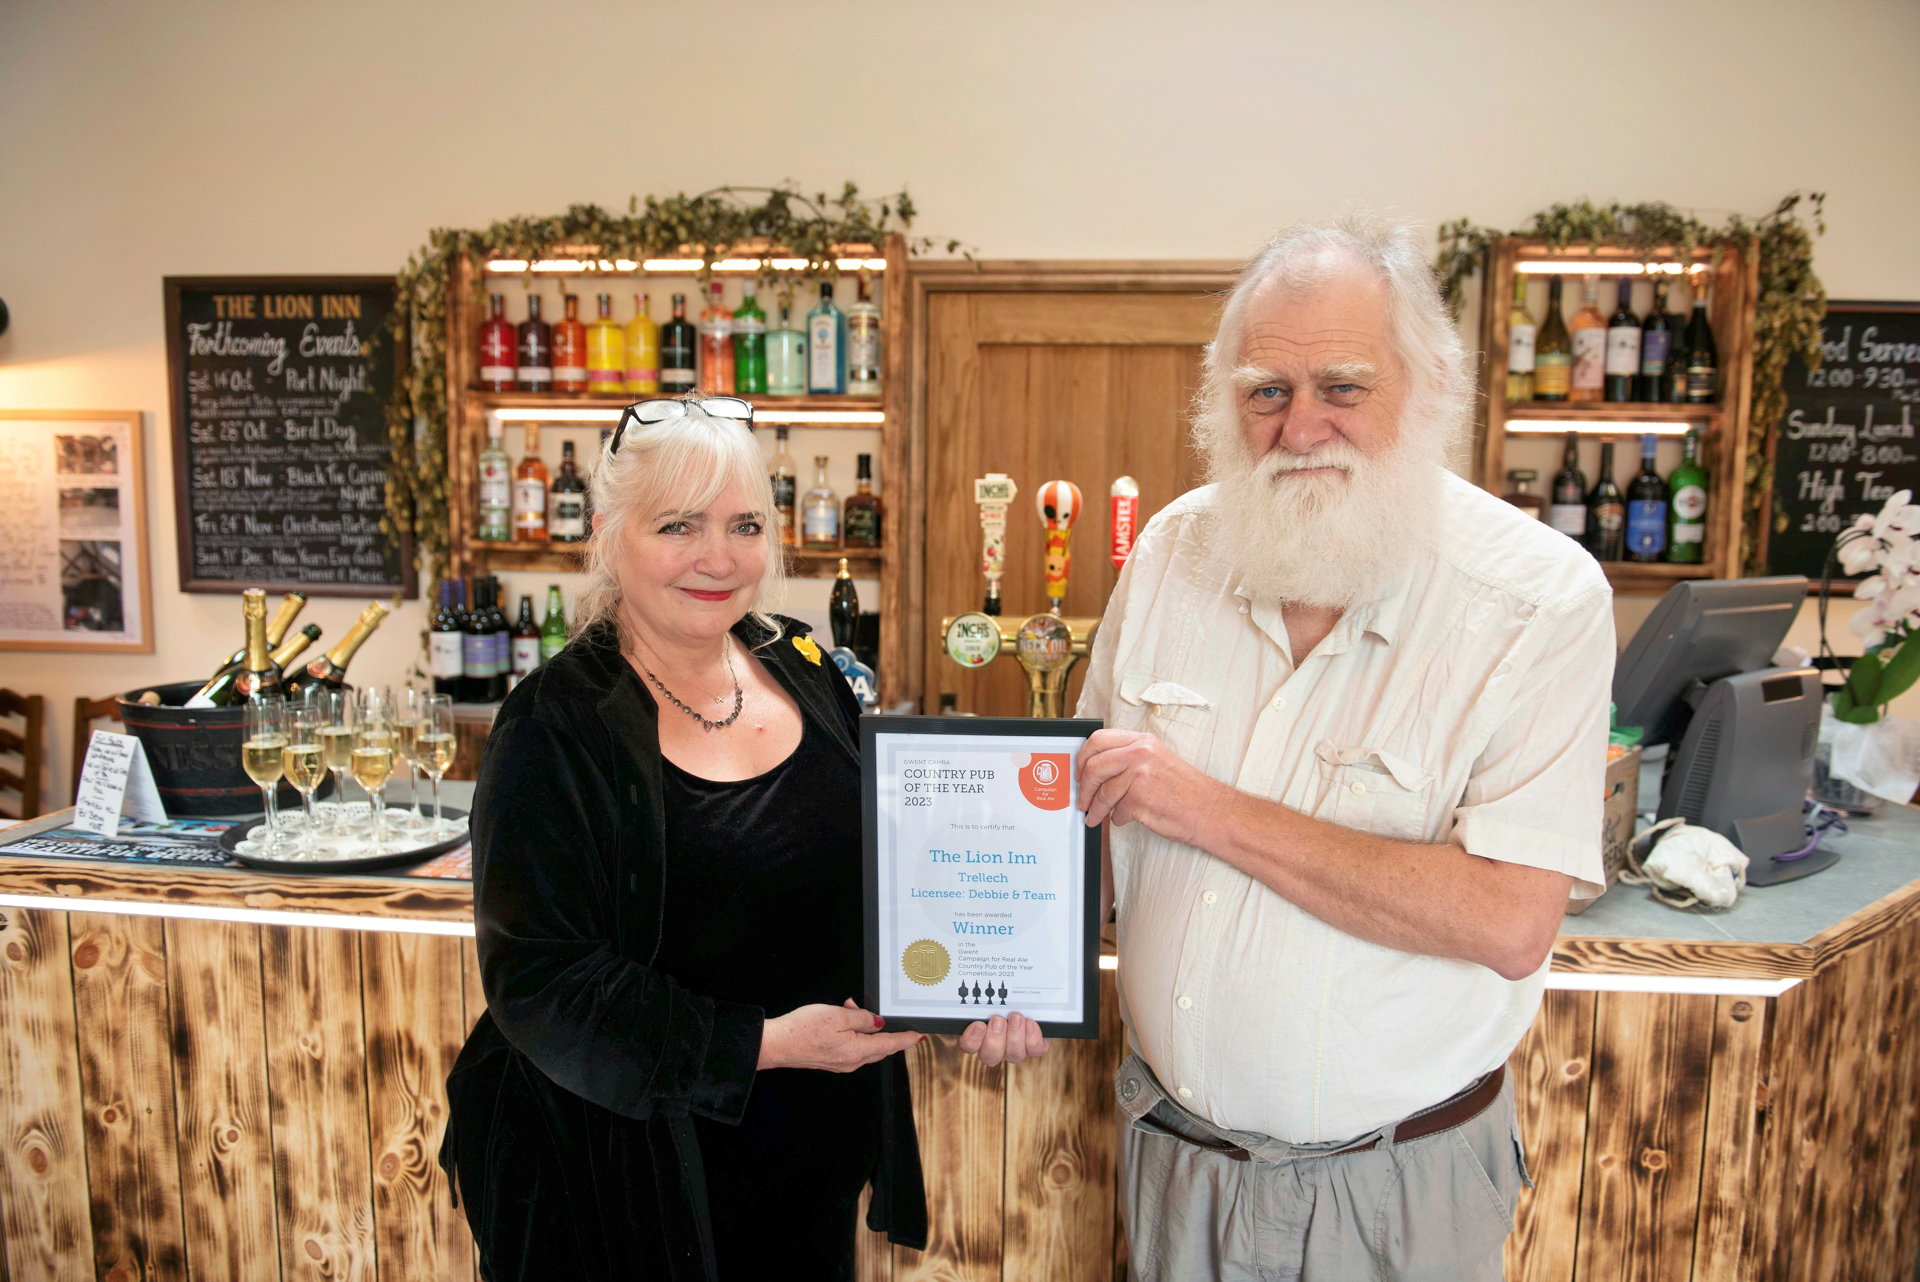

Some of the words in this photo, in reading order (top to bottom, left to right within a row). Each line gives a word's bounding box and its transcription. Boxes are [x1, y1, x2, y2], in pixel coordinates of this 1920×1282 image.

[213, 295, 256, 318] THE
[264, 295, 314, 318] LION
[321, 295, 361, 318] INN
[187, 321, 288, 376] Forthcoming
[300, 320, 362, 358] Events
[285, 366, 317, 392] Port
[320, 364, 366, 402] Night
[284, 416, 320, 441] Bird
[322, 418, 357, 453] Dog
[1786, 406, 1857, 449] Sunday
[1858, 404, 1915, 442] Lunch
[244, 465, 273, 487] Nov
[286, 464, 328, 486] Black
[325, 463, 346, 485] Tie
[340, 485, 377, 508] Night
[1798, 469, 1845, 515] High
[1855, 471, 1894, 501] Tea
[195, 513, 218, 534] Fri
[244, 513, 273, 534] Nov
[283, 514, 341, 535] Christmas
[1115, 498, 1131, 553] AMSTEL
[196, 546, 220, 565] Sun
[272, 548, 297, 565] New
[328, 546, 352, 566] Eve
[1020, 639, 1049, 653] NECK
[1051, 639, 1069, 653] OIL
[904, 769, 966, 779] COUNTRY
[970, 770, 995, 780] PUB
[904, 783, 921, 793] OF
[924, 783, 950, 793] THE
[952, 784, 985, 793] YEAR
[904, 797, 933, 806] 2023
[9, 842, 139, 857] BEAUTIFUL
[145, 851, 225, 861] BEERS
[929, 849, 961, 863] The
[966, 850, 1003, 864] Lion
[1008, 851, 1037, 864] Inn
[958, 872, 1008, 883] Trellech
[911, 888, 965, 899] Licensee:
[969, 889, 1009, 899] Debbie
[1012, 890, 1020, 900] &
[1023, 890, 1056, 900] Team
[952, 921, 1015, 935] Winner
[958, 970, 997, 978] Competition
